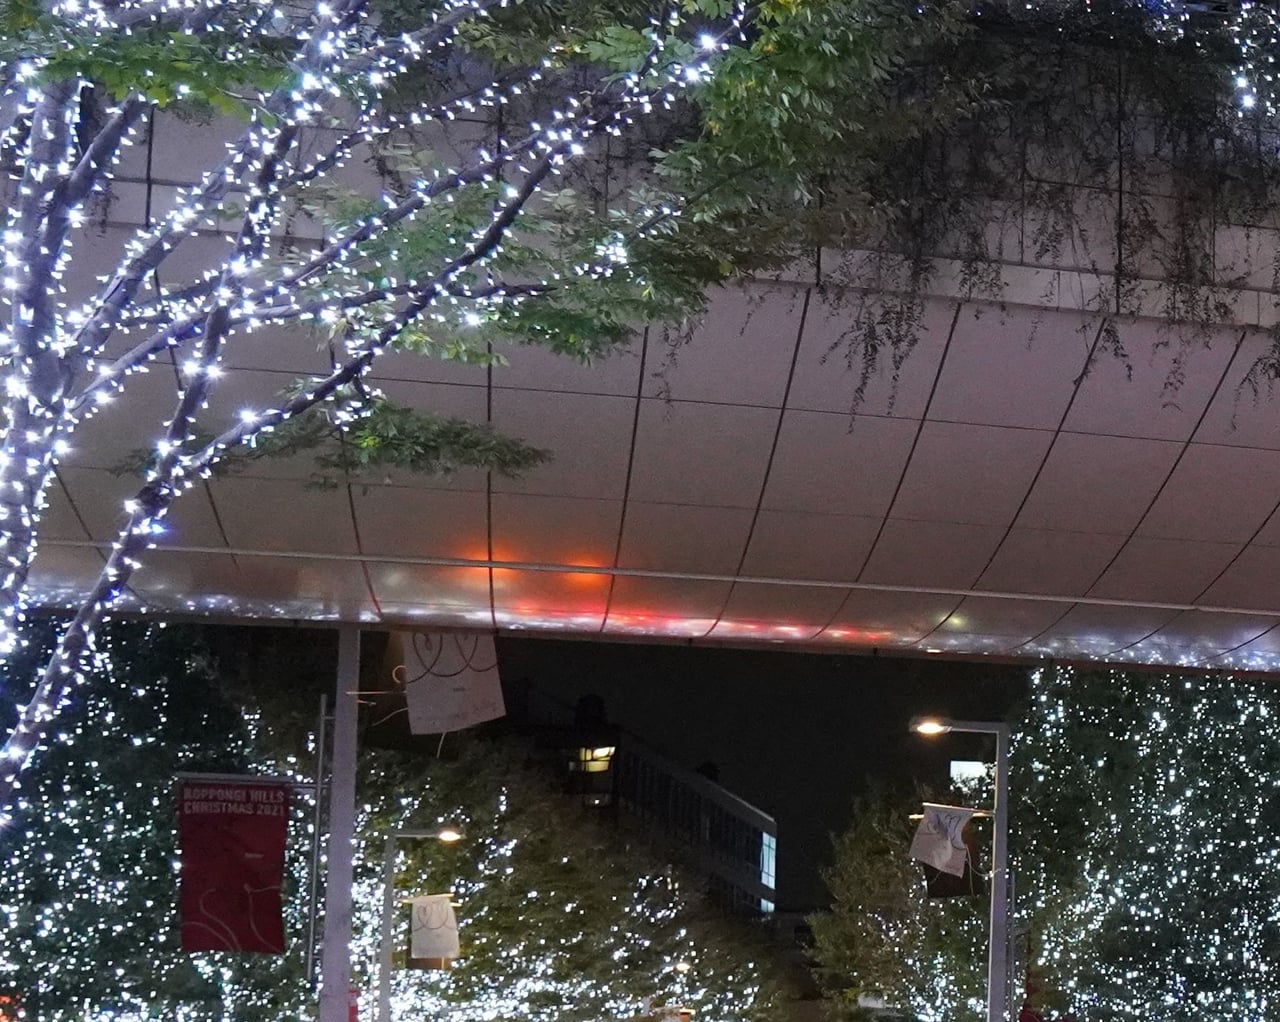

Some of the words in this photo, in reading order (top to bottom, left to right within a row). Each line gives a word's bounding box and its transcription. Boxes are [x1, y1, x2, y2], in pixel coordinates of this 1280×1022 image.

[183, 788, 247, 801] ROPPONGI
[183, 801, 254, 815] CHRISTMAS
[256, 805, 285, 816] 2021
